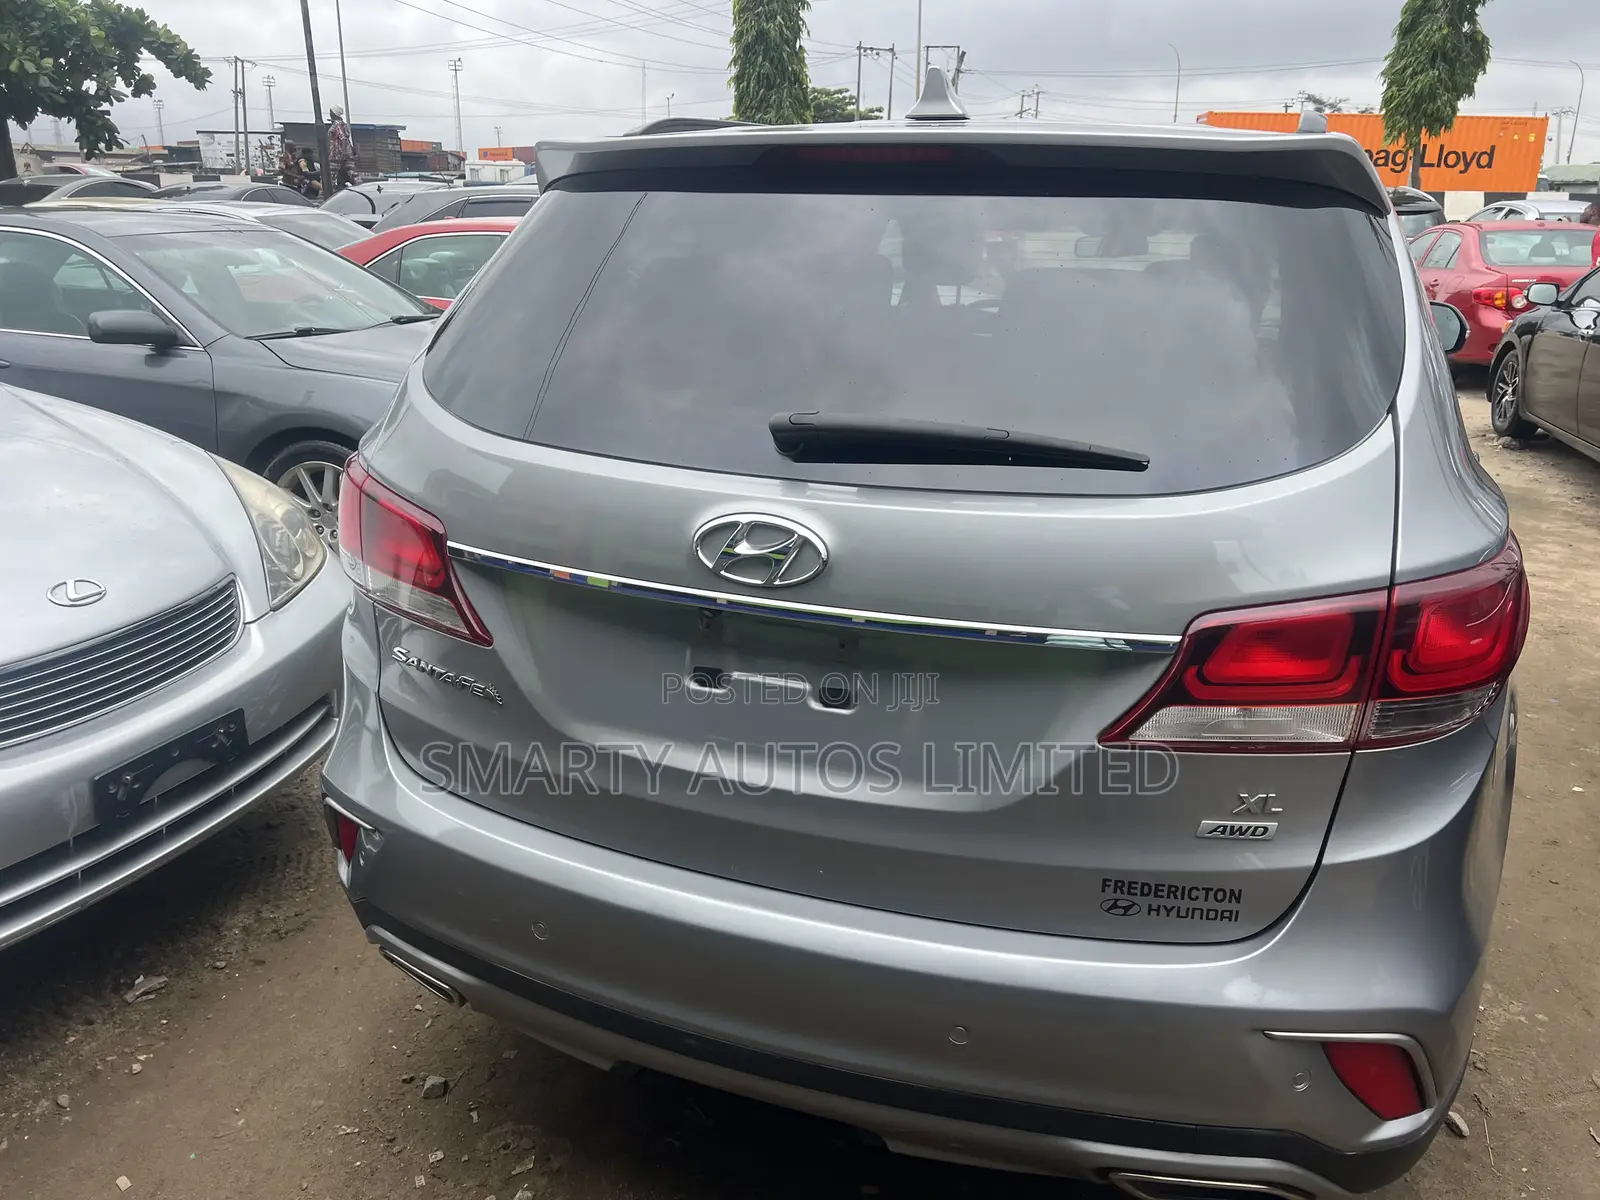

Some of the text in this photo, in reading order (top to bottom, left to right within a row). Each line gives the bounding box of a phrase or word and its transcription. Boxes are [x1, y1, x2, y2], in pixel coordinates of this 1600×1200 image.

[1232, 793, 1284, 814] XL
[1205, 824, 1270, 838] AWD
[1101, 878, 1243, 904] FREDERICTON
[1147, 903, 1240, 923] HYUNDAI
